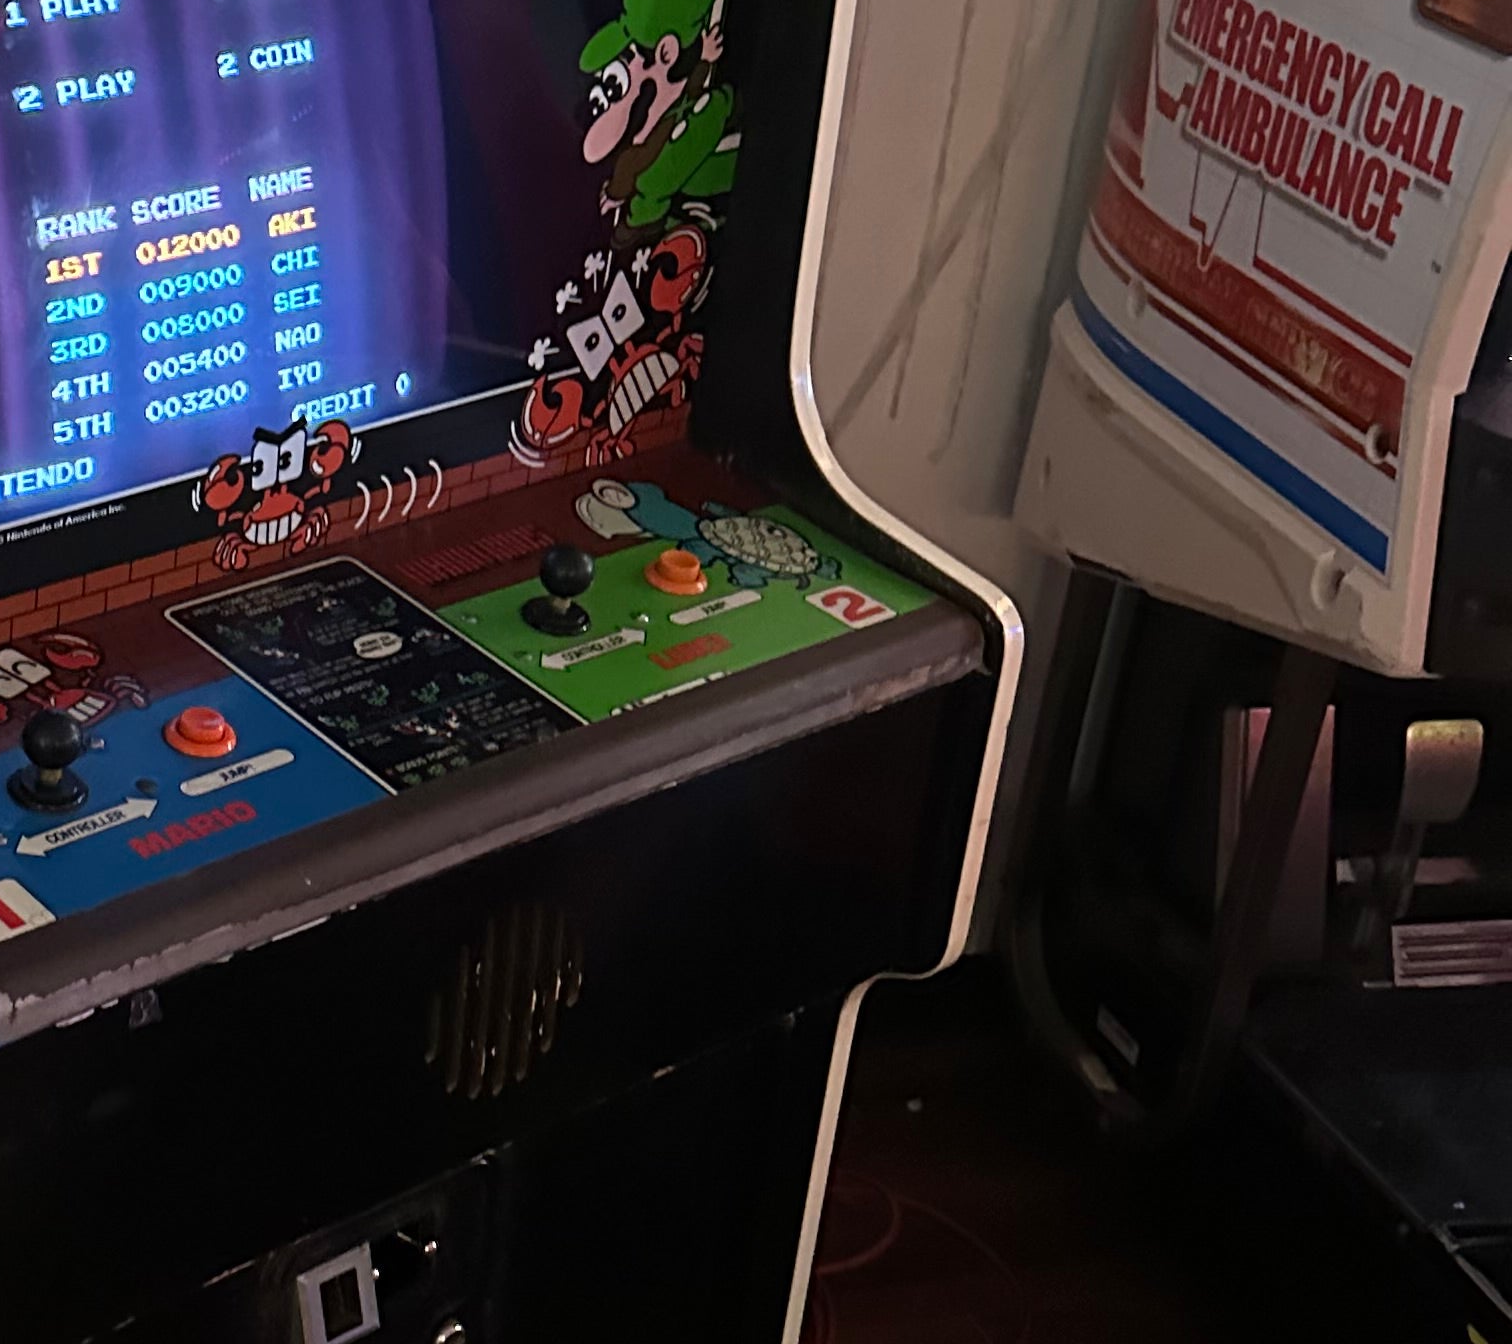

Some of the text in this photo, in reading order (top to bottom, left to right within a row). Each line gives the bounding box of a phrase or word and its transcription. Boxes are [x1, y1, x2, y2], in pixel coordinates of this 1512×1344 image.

[5, 0, 28, 27] 1
[18, 38, 314, 113] 2 PLAY 2 COIN
[1190, 67, 1410, 246] AMBULANCE
[1364, 71, 1463, 186] CALL
[38, 166, 314, 244] RANK SCORE NAME
[45, 207, 317, 283] 1ST 012000 AKI
[45, 245, 319, 323] 2ND 009000 CHI
[49, 283, 322, 364] 3RD 008000 SEI
[51, 322, 322, 402] 4TH 005400 NAO
[53, 361, 323, 443] 5TH 003200 IYO
[291, 384, 376, 423] CREDIT
[7, 523, 53, 543] Nintendo
[54, 519, 64, 530] of
[65, 508, 107, 526] America
[821, 589, 886, 623] 2
[45, 808, 126, 845] CONTROLLER
[128, 799, 257, 859] MARIO
